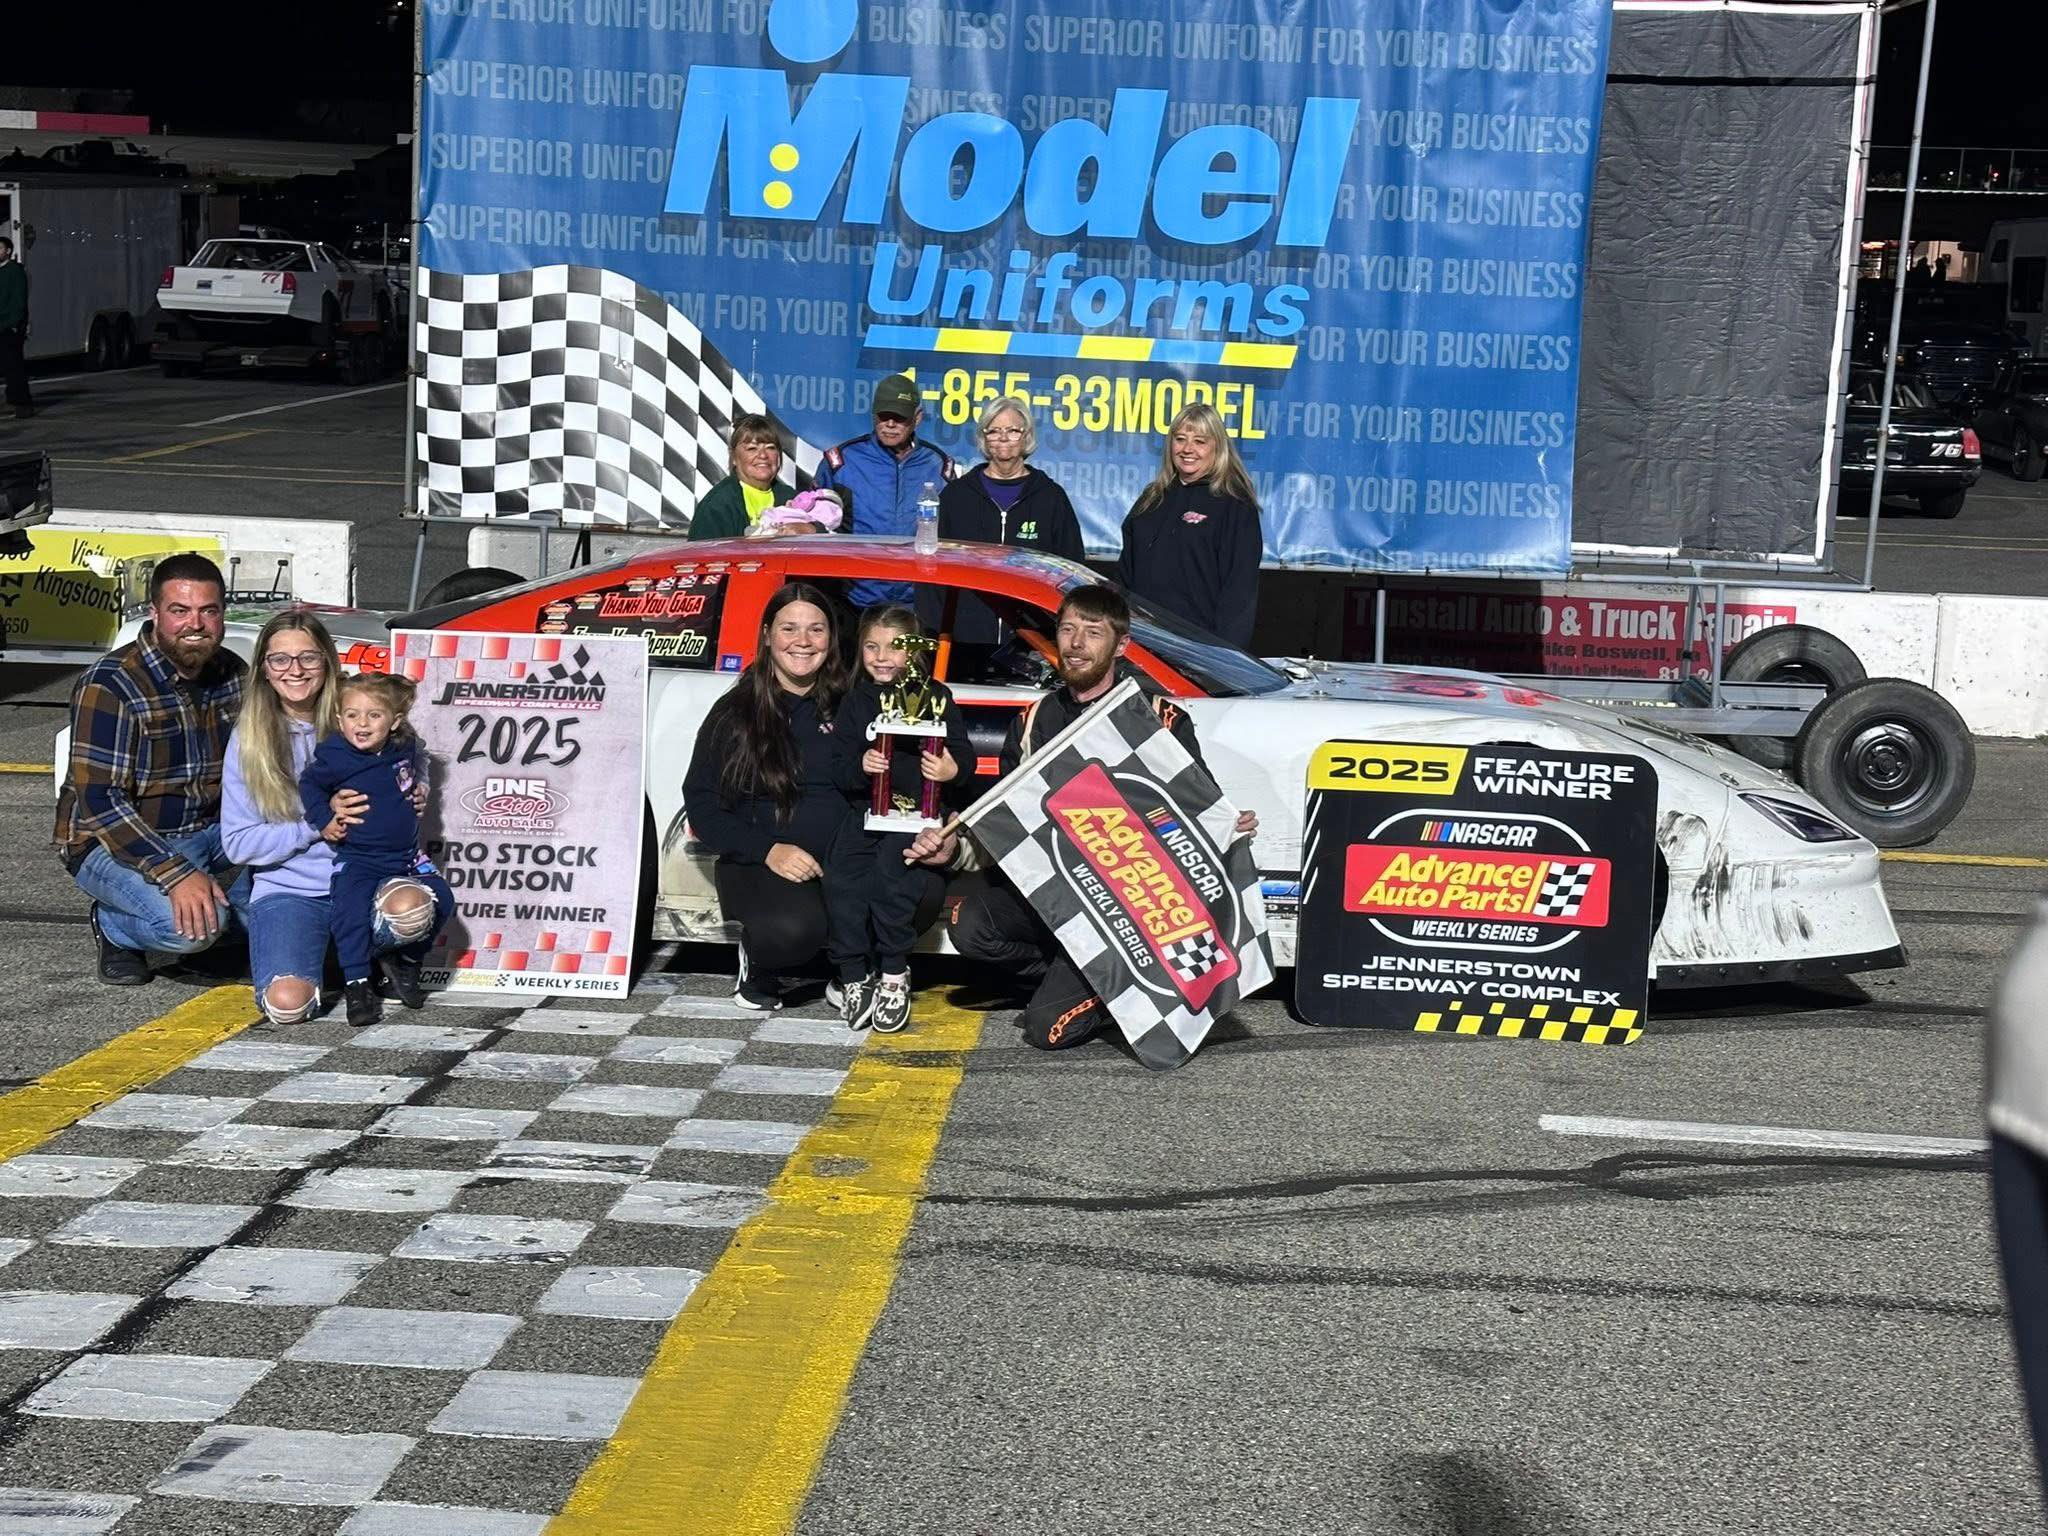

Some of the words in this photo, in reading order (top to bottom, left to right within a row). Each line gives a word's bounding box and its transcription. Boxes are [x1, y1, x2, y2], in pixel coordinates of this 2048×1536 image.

[584, 0, 713, 33] UNIFORM
[869, 5, 1007, 50] BUSINESS
[1024, 14, 1164, 58] SUPERIOR
[1173, 20, 1303, 64] UNIFORM
[1311, 27, 1365, 67] FOR
[1376, 30, 1449, 69] YOUR
[1457, 32, 1598, 75] BUSINESS
[431, 57, 574, 104] SUPERIOR
[583, 68, 686, 110] UNIFOR
[903, 86, 1004, 124] SINESS
[1021, 94, 1112, 132] SUPER
[1370, 110, 1443, 149] YOUR
[1451, 112, 1591, 154] BUSINESS
[431, 133, 572, 178] SUPERIOR
[582, 143, 674, 184] UNIFO
[664, 65, 1360, 248] Model
[1365, 185, 1439, 222] YOUR
[1446, 188, 1584, 229] BUSINESS
[430, 203, 571, 247] SUPERIOR
[581, 213, 707, 257] UNIFORM
[717, 219, 769, 260] FOR
[779, 224, 850, 265] YOUR
[261, 272, 280, 284] 77
[867, 241, 1310, 338] Uniforms
[1295, 251, 1350, 290] FOR
[1360, 255, 1433, 293] YOUR
[1441, 258, 1577, 299] BUSINESS
[714, 293, 766, 332] FOR
[776, 297, 848, 337] YOUR
[1355, 328, 1428, 366] YOUR
[1436, 331, 1571, 371] BUSINESS
[774, 373, 845, 413] YOUR
[1287, 401, 1341, 439] FOR
[1350, 404, 1422, 443] YOUR
[1429, 408, 1565, 448] BUSINESS
[1929, 442, 1963, 457] 76
[1282, 472, 1336, 510] FOR
[1345, 476, 1417, 514] YOUR
[1425, 479, 1560, 518] BUSINESS
[1352, 591, 1478, 633] Tnstall
[1483, 601, 1553, 635] Auto
[1559, 605, 1582, 636] &
[1588, 602, 1677, 640] Truck
[432, 682, 606, 706] JENNERSTOWN
[457, 714, 581, 768] 2025
[1329, 756, 1450, 783] 2025
[1474, 757, 1635, 783] FEATURE
[1472, 776, 1612, 800] WINNER
[481, 796, 551, 819] Stop
[486, 778, 546, 801] ONE
[475, 818, 510, 828] AUTO
[512, 819, 553, 829] SALES
[1448, 821, 1538, 847] NASCAR
[428, 840, 489, 864] PRO
[497, 843, 598, 867] STOCK
[1060, 807, 1119, 867] Auto
[1109, 865, 1169, 934] Parts
[1090, 807, 1202, 926] Advance
[1163, 828, 1225, 904] NASCAR
[1380, 853, 1533, 888] Advance
[446, 867, 573, 893] DIVISON
[1359, 881, 1439, 908] Auto
[1439, 885, 1525, 914] Parts
[454, 902, 506, 919] TURE
[514, 905, 607, 923] WINNER
[1071, 862, 1122, 922] WEEKLY
[1113, 911, 1153, 968] SERIES
[1411, 919, 1478, 939] WEEKLY
[1478, 922, 1539, 943] SERIES
[420, 970, 450, 985] CAR
[515, 977, 572, 989] WEEKLY
[574, 979, 619, 990] SERIES
[1362, 955, 1581, 982] JENNERSTOWN
[1323, 974, 1479, 996] SPEEDWAY
[1481, 982, 1621, 1007] COMPLEX
